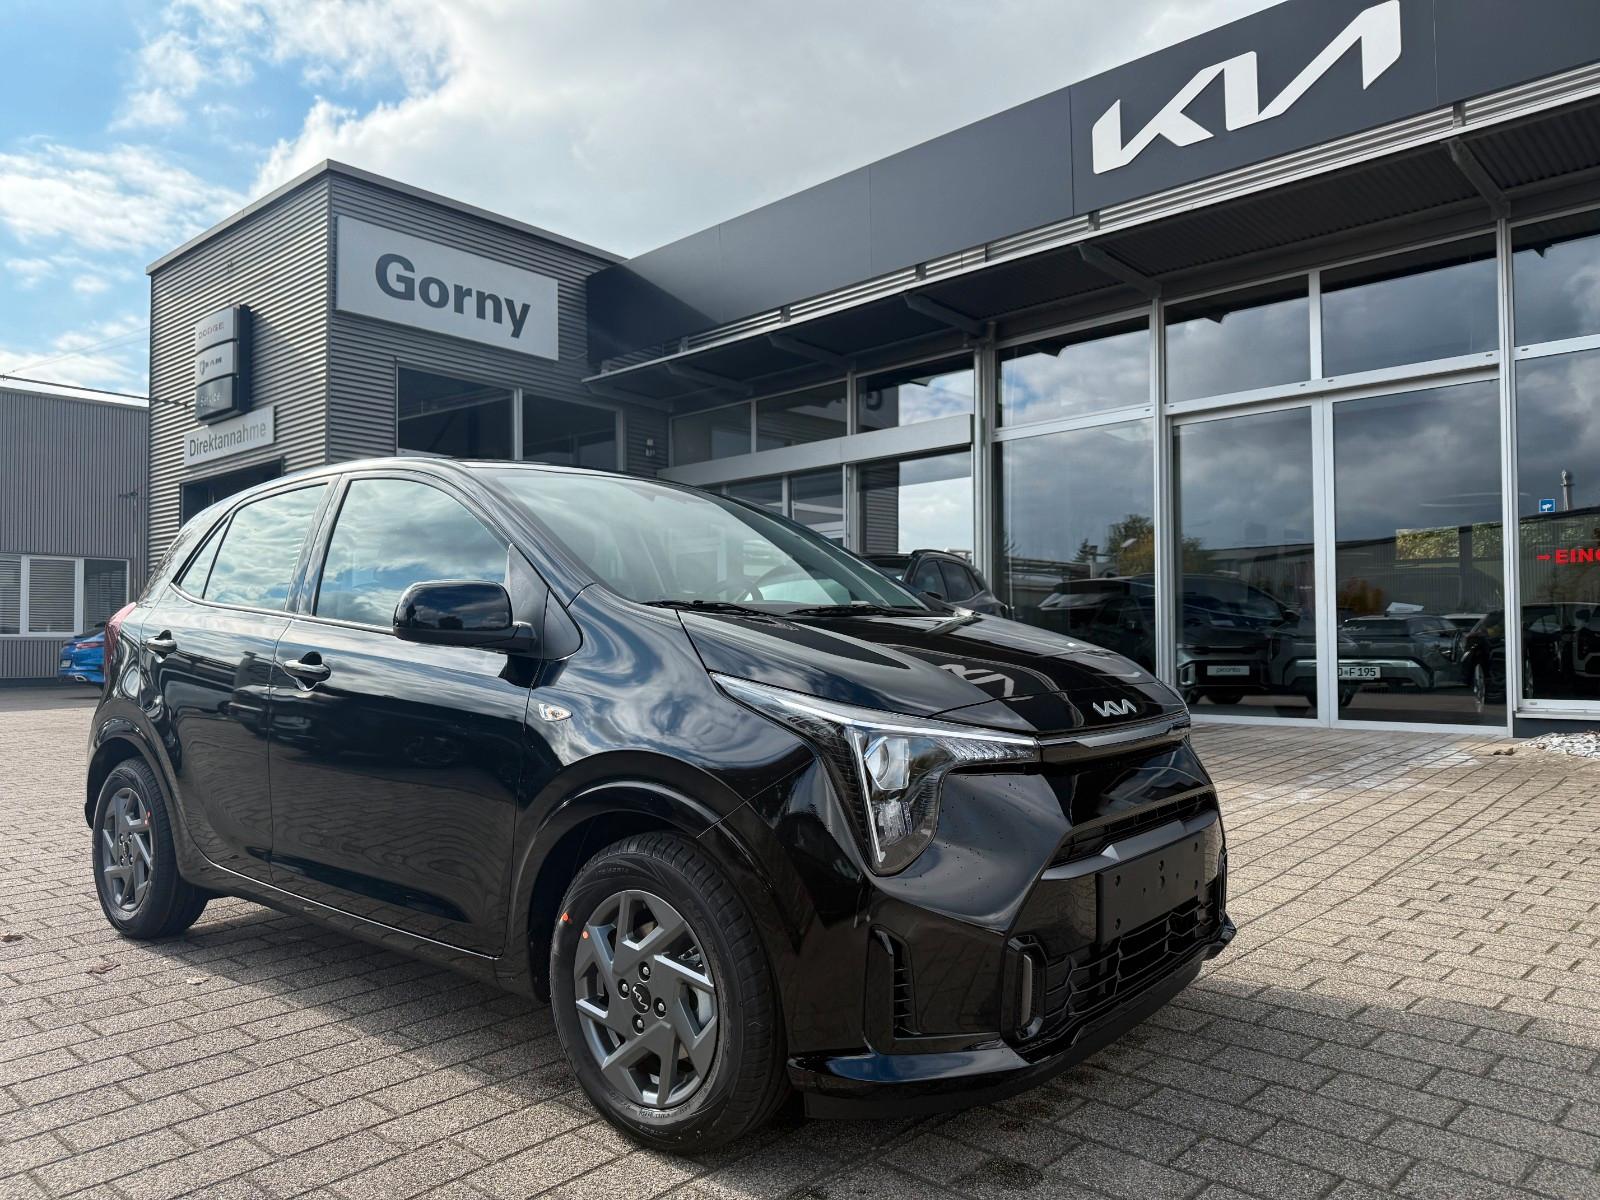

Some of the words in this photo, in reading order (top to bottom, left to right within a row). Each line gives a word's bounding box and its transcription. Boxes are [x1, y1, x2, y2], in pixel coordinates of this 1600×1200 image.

[1092, 0, 1401, 174] KIA
[375, 253, 531, 339] Gorny
[198, 321, 225, 339] DODGE
[189, 422, 266, 457] Direktannahme
[1092, 698, 1137, 717] KIA
